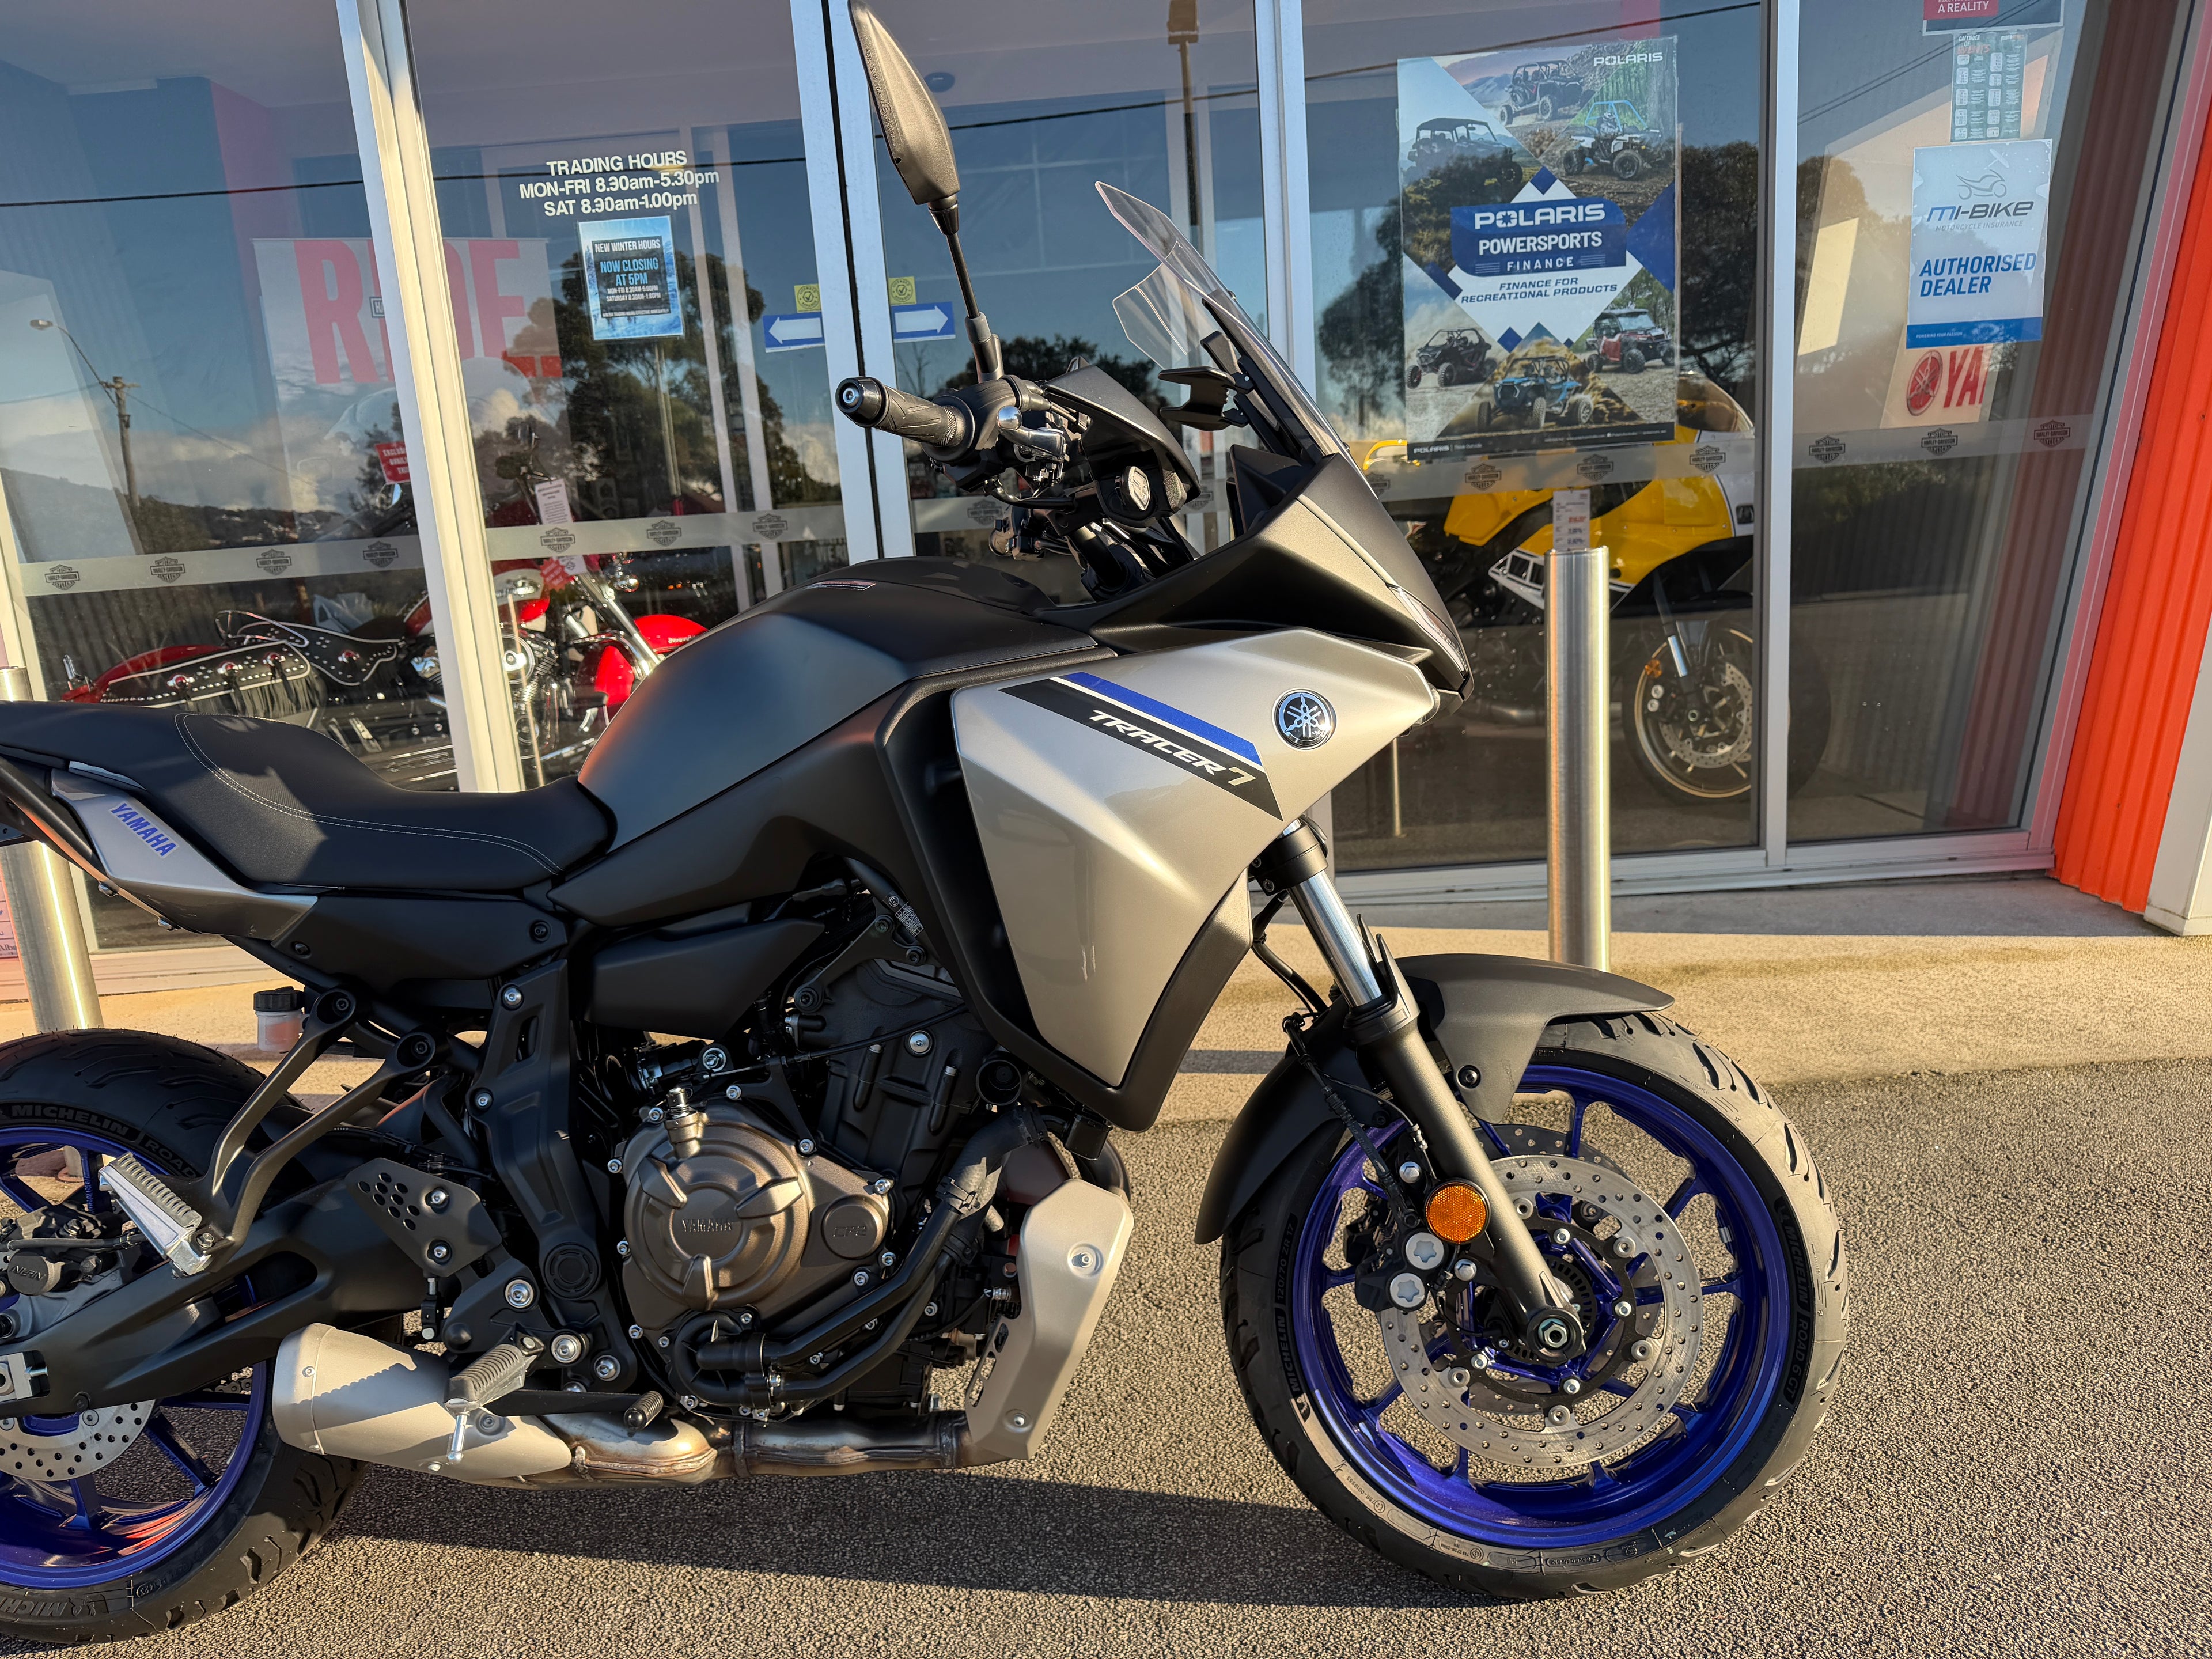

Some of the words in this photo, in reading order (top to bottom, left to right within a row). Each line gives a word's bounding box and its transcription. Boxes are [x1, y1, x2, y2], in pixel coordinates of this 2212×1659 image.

[1938, 5, 1945, 13] A
[1948, 2, 1989, 12] REALITY
[1593, 52, 1663, 67] POLARIS
[546, 156, 623, 176] TRADING
[628, 150, 687, 169] HOURS
[520, 179, 591, 199] MON-FRI
[544, 200, 576, 217] SAT
[1475, 203, 1606, 229] POLARIS
[1936, 222, 1982, 232] MOTORCYCLE
[1983, 219, 2023, 229] INSURANCE
[594, 243, 611, 253] NEW
[611, 241, 639, 252] WINTER
[638, 239, 661, 249] HOURS
[1479, 231, 1603, 255] POWERSPORTS
[600, 260, 620, 273] NOW
[622, 257, 659, 271] CLOSING
[1507, 257, 1574, 271] FINANCE
[1919, 253, 2037, 276] AUTHORISED
[616, 274, 627, 286] AT
[628, 272, 648, 285] 5PM
[1499, 279, 1552, 290] FINANCE
[1555, 278, 1578, 287] FOR
[1920, 276, 1992, 297] DEALER
[1461, 290, 1551, 303] RECREATIONAL
[1553, 284, 1618, 296] PRODUCTS
[111, 803, 176, 857] YAMAHA
[12, 1105, 129, 1136] MICHELIN
[145, 1141, 198, 1178] ROAD
[682, 1218, 733, 1233] YAMAHA
[1286, 1222, 1294, 1236] 17
[1279, 1239, 1291, 1254] ZR
[1784, 1225, 1809, 1305] MICHELIN
[1277, 1257, 1287, 1301] 120/70
[1794, 1318, 1808, 1361] ROAD
[1278, 1315, 1301, 1392] MICHELIN
[1792, 1365, 1802, 1376] 6
[1786, 1377, 1798, 1399] GT
